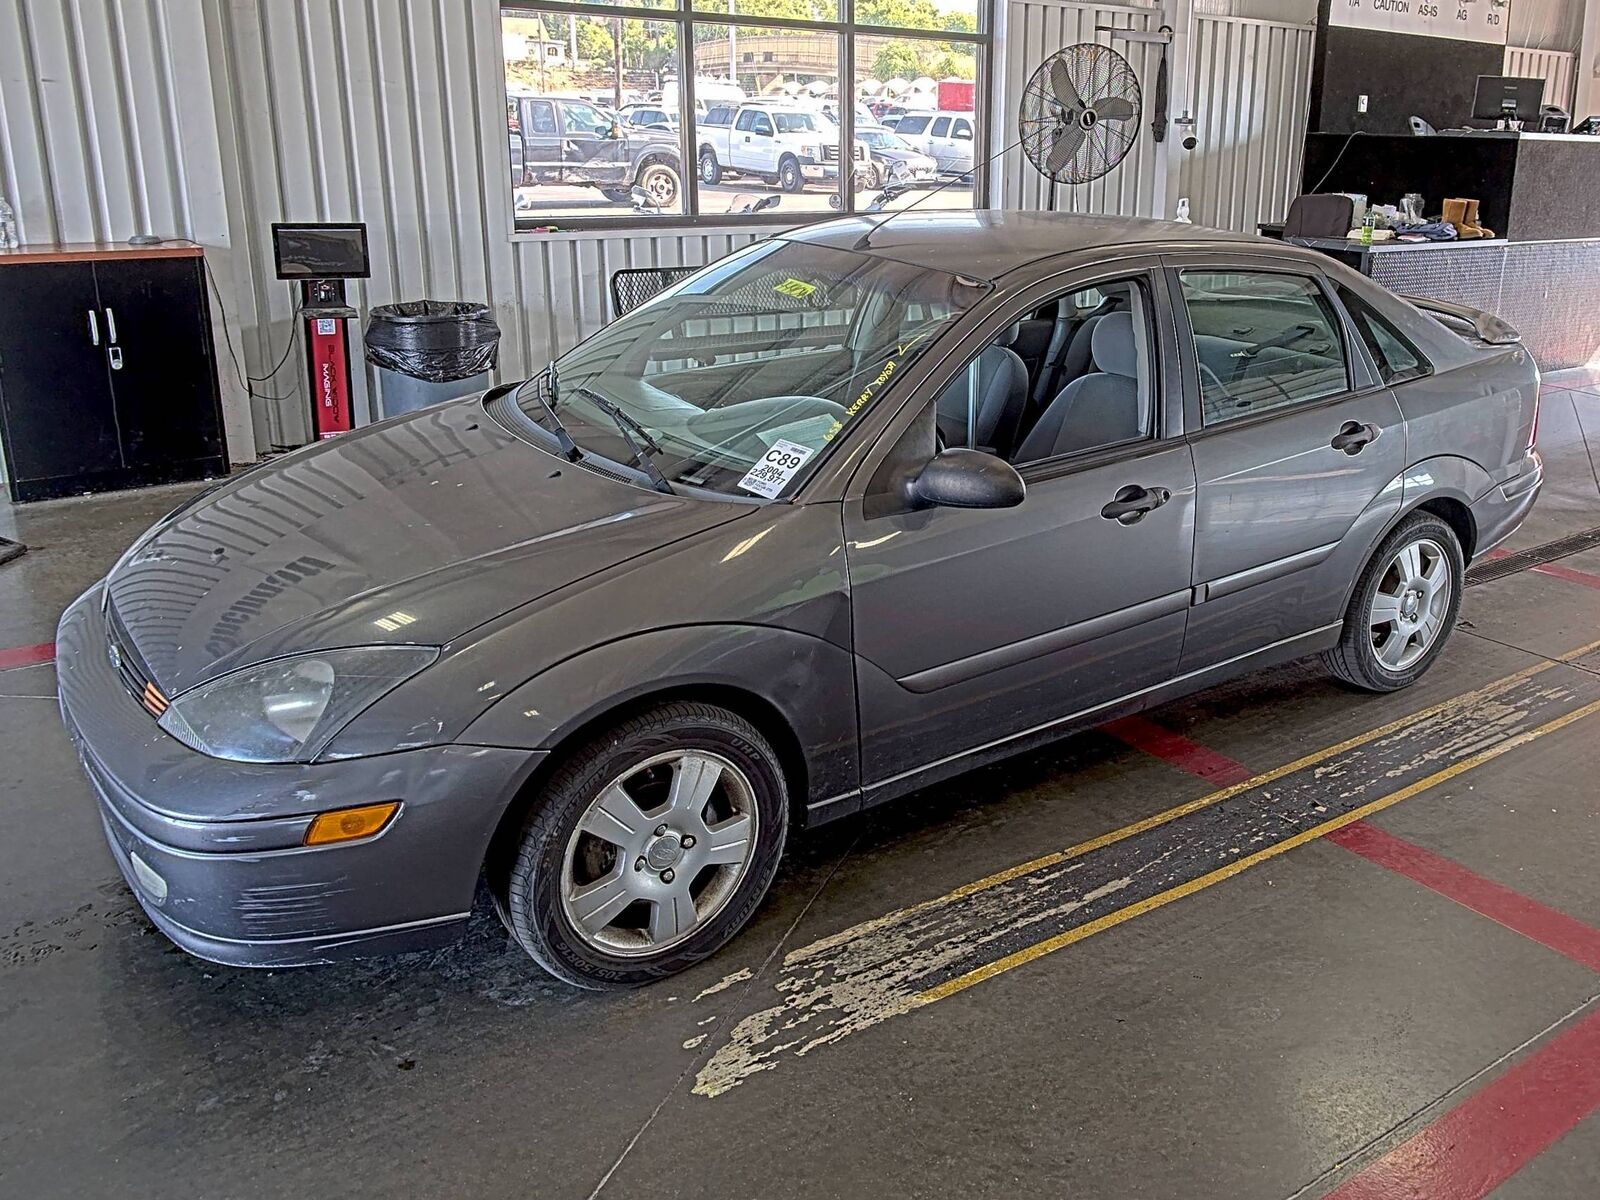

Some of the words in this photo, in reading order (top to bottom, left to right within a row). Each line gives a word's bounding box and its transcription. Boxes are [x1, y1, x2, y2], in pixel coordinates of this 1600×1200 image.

[1374, 0, 1410, 13] CAUTION
[1418, 5, 1438, 17] AS-IS
[1456, 9, 1468, 21] AG
[1487, 14, 1500, 25] R/D
[328, 344, 336, 382] BLACK
[322, 363, 332, 407] IMAGING
[845, 388, 874, 416] KERRY
[761, 464, 785, 477] 2004
[765, 449, 801, 470] C89
[750, 468, 786, 485] 229,977
[730, 738, 760, 760] UHP
[556, 942, 627, 980] 205/50R16
